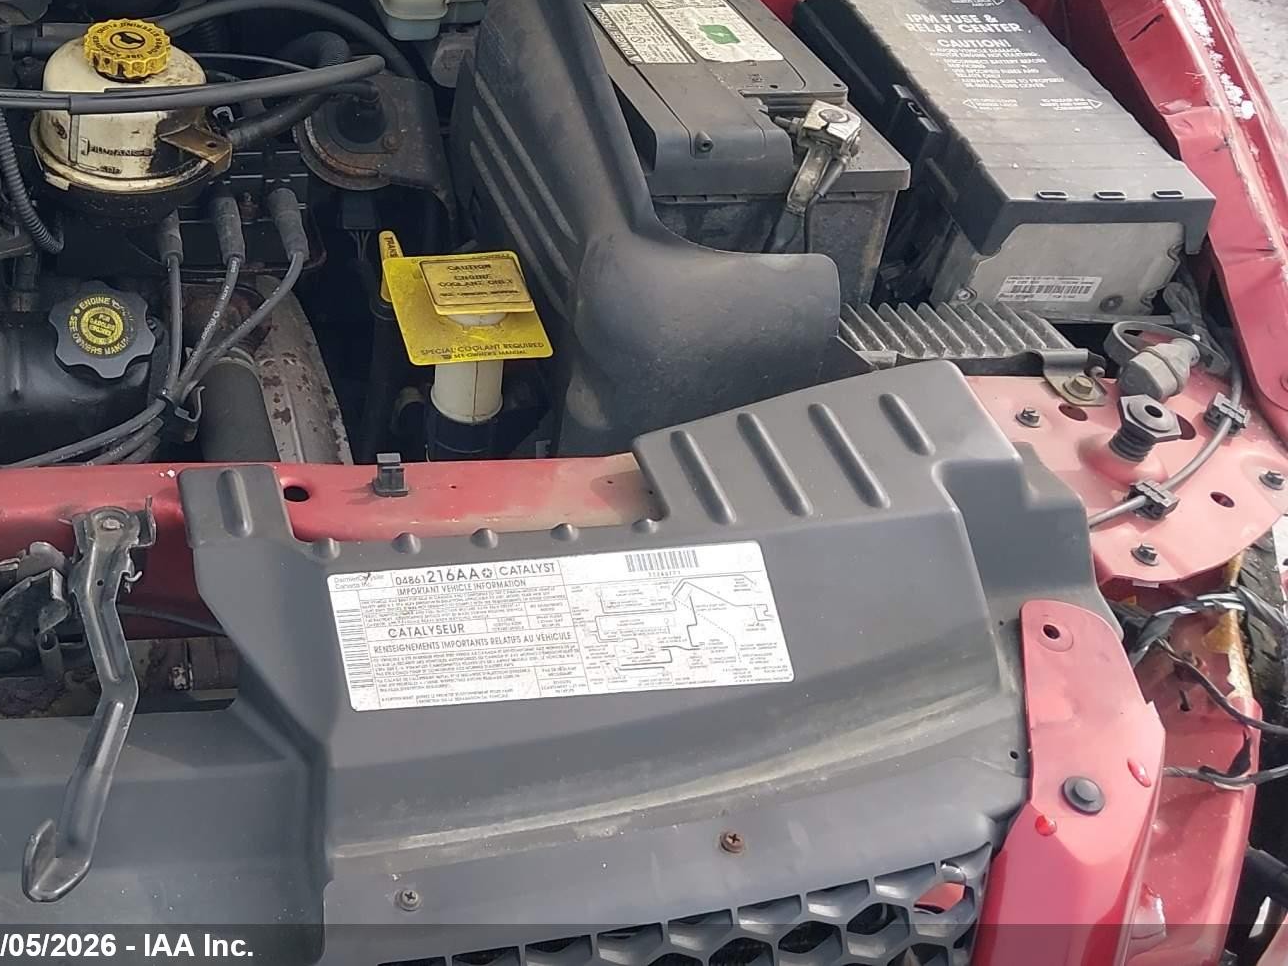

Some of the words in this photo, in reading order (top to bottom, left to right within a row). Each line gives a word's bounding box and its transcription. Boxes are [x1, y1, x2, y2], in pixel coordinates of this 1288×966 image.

[904, 13, 940, 24] IPM
[940, 13, 983, 24] FUSE
[983, 14, 999, 24] &
[903, 22, 953, 34] RELAY
[957, 22, 1024, 34] CENTER
[937, 38, 1012, 48] CAUTION!
[447, 264, 492, 272] CAUTION
[438, 280, 483, 289] COOLANT
[487, 278, 514, 286] ONLY
[79, 296, 111, 309] ENGINE
[420, 346, 457, 356] SPECIAL
[459, 344, 502, 353] COOLANT
[503, 341, 545, 350] REQUIRED
[498, 562, 556, 577] CATALYST
[396, 585, 440, 596] IMPORTANT
[441, 582, 472, 594] VEHICLE
[472, 579, 527, 591] INFORMATION
[387, 622, 465, 638] CATALYSEUR
[373, 641, 441, 654] RENSEIGNEMENTS
[441, 638, 489, 651] IMPORTANTS
[490, 635, 522, 645] RELATIFS
[523, 634, 534, 643] AU
